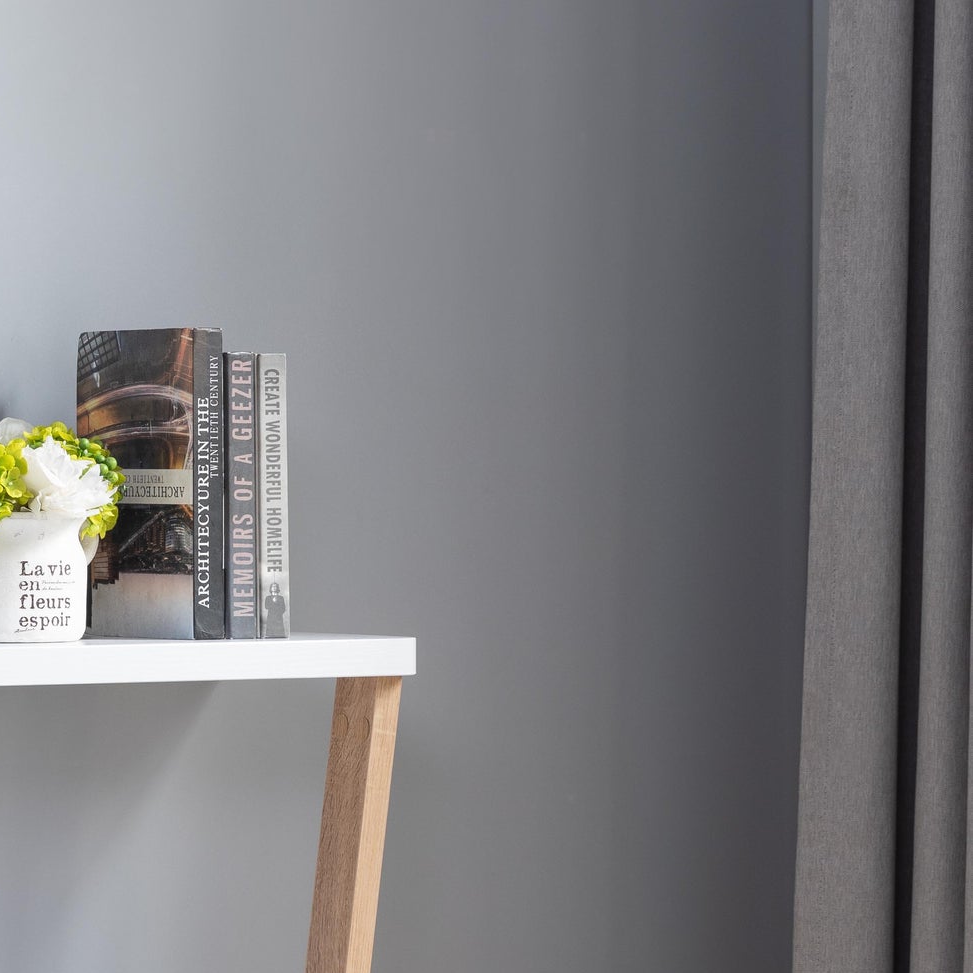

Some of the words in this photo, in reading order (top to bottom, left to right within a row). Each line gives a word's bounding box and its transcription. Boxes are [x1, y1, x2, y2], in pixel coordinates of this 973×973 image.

[209, 355, 219, 407] CENTURY
[231, 359, 253, 441] GEEZER
[264, 368, 281, 416] CREATE
[197, 397, 210, 436] THE
[197, 439, 210, 460] IN
[210, 411, 219, 478] TWENTIETH
[233, 453, 253, 465] A
[265, 420, 282, 503] WONDERFUL
[123, 485, 185, 498] ARCHITECYUR
[233, 475, 254, 502] OF
[197, 464, 210, 609] ARCHITECYURE
[266, 507, 283, 573] HOMELIFE
[19, 560, 45, 577] La
[47, 560, 72, 577] vie
[232, 513, 255, 617] MEMOIRS
[18, 580, 41, 592] en
[18, 594, 72, 610] fleurs
[18, 612, 72, 631] espoir
